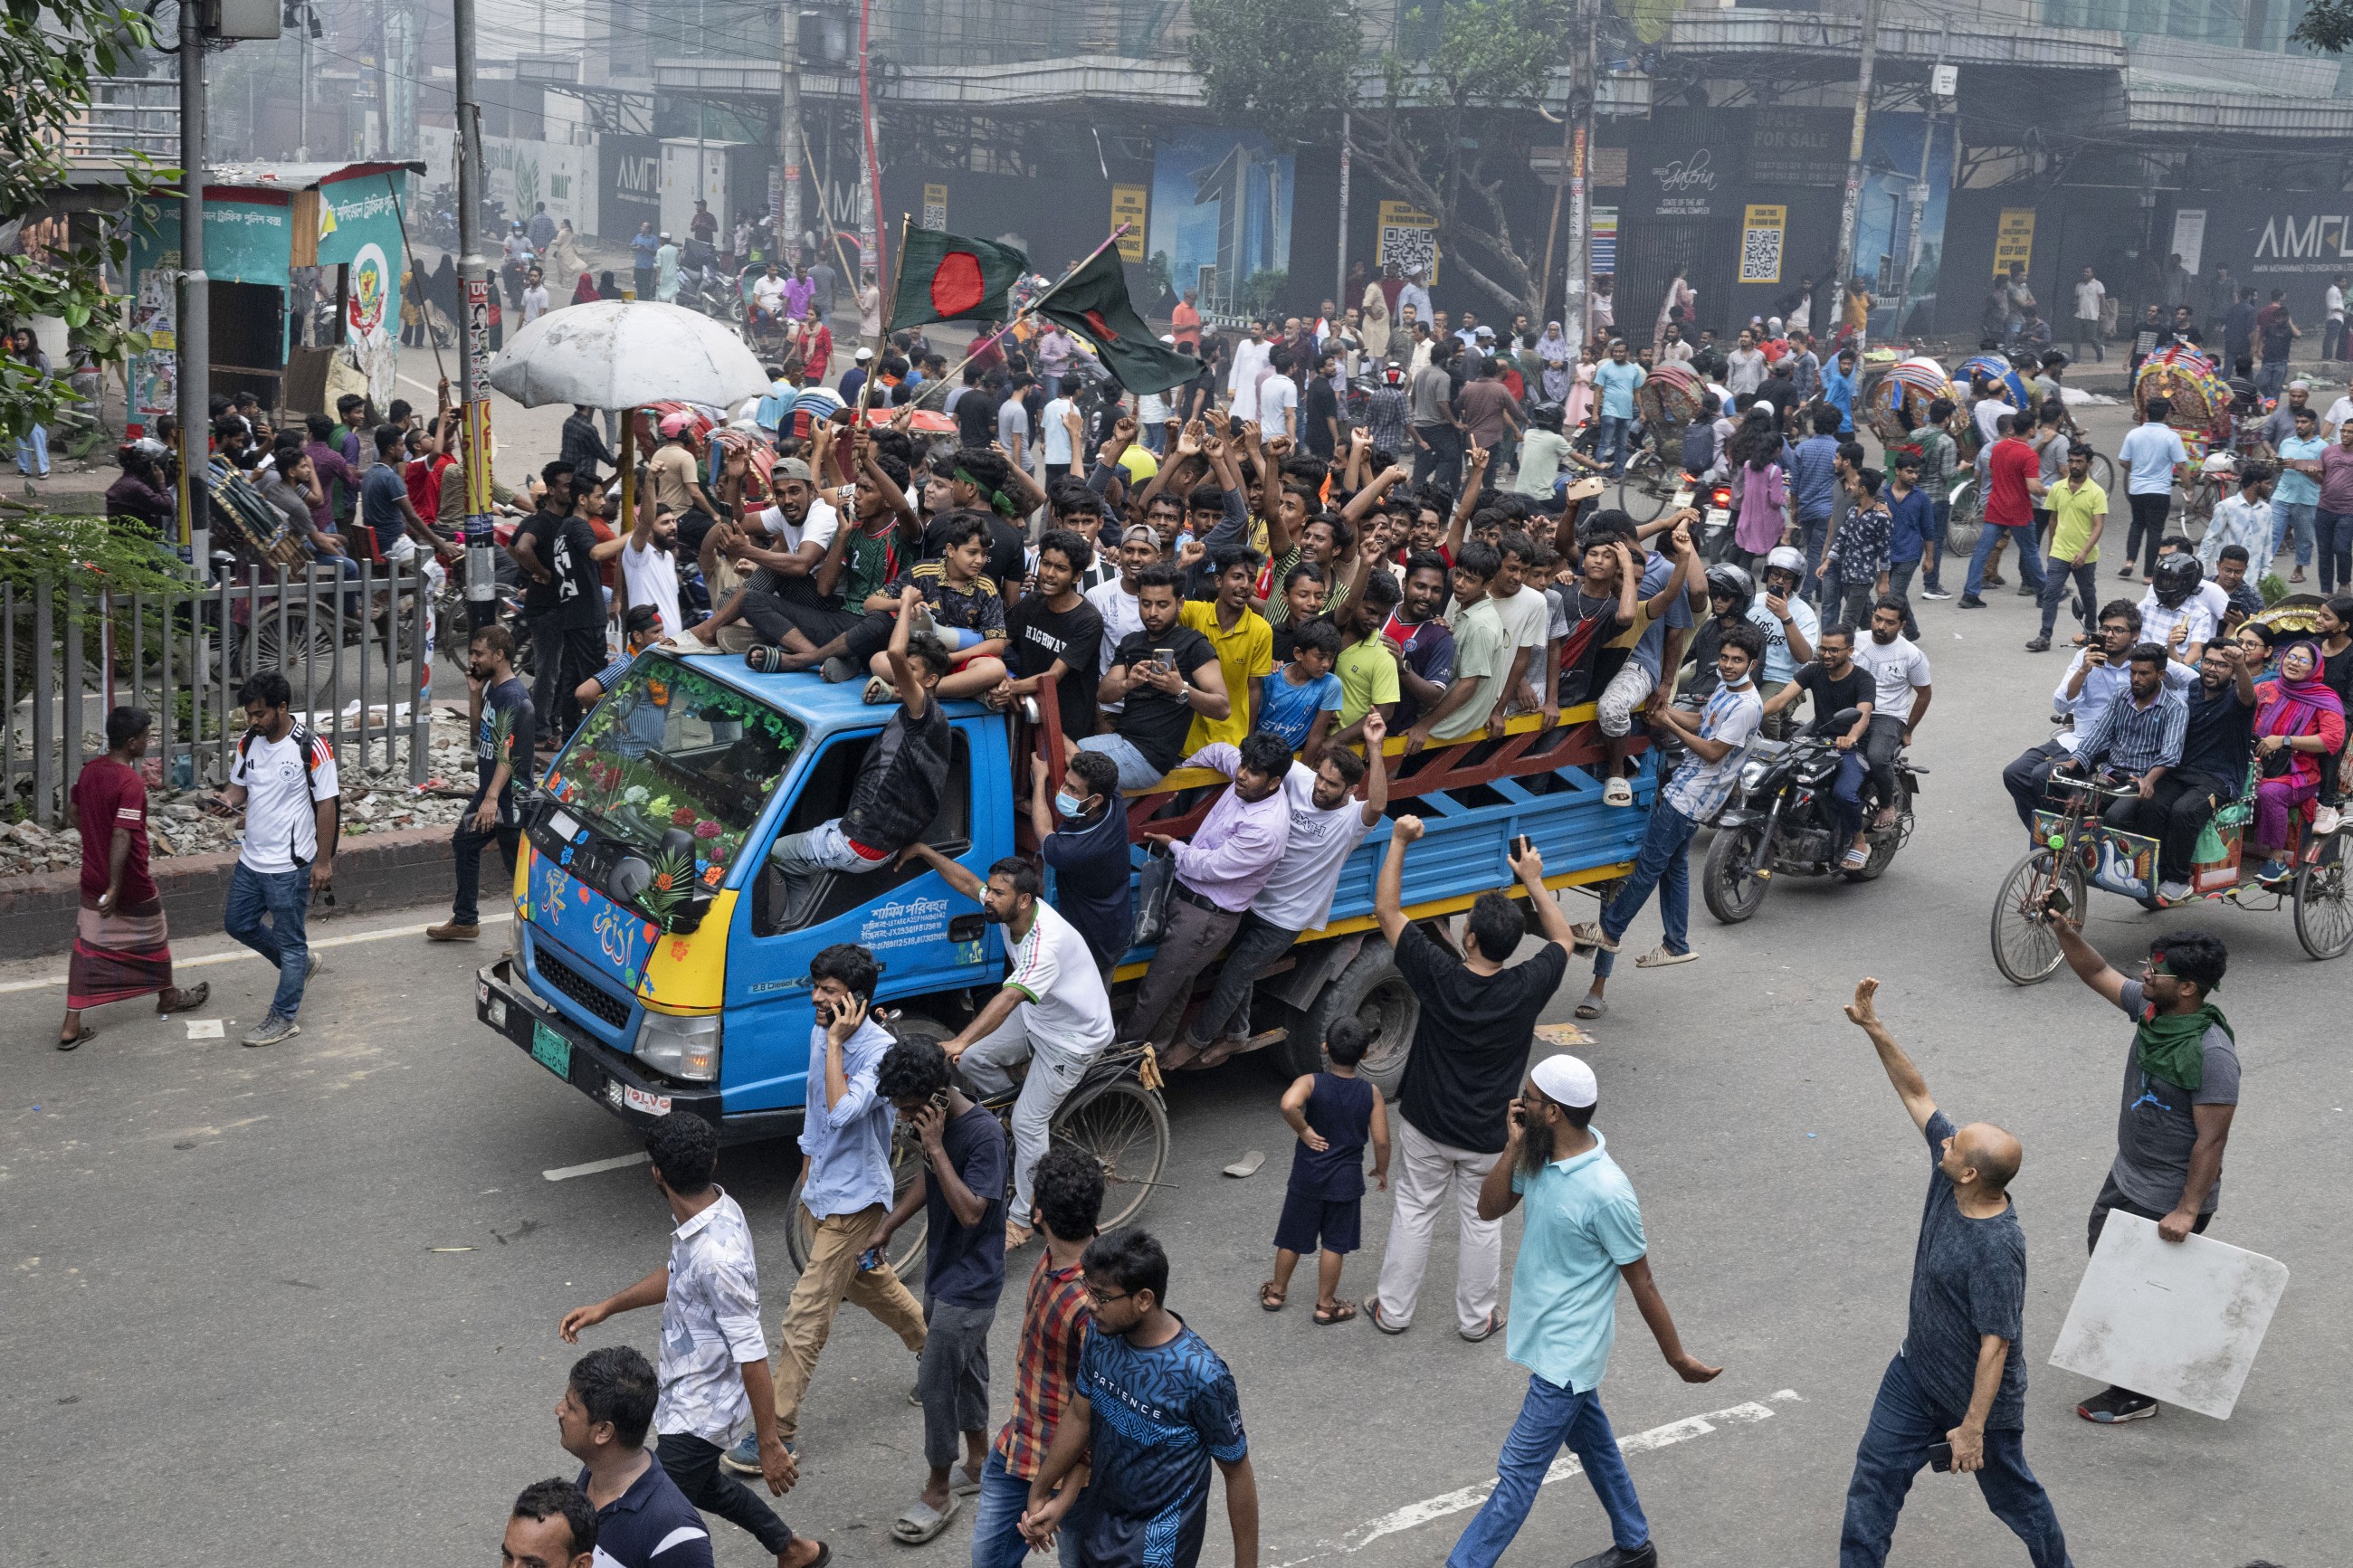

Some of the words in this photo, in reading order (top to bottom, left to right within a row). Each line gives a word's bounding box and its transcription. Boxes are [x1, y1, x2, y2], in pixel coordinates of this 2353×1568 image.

[1754, 131, 1785, 147] FOR
[1790, 133, 1828, 147] SALE
[244, 212, 265, 225] পুলিশ
[2253, 264, 2268, 272] AMIN
[2269, 264, 2304, 272] MOHAMMAD
[2306, 264, 2342, 272] FOUNDATION
[1024, 624, 1067, 653] HIGHWAY
[1291, 809, 1327, 839] PATH
[906, 898, 949, 916] পরিবহন
[752, 982, 766, 993] 2.8
[767, 979, 793, 990] Diesel
[625, 1086, 672, 1110] VOLVO
[1092, 1370, 1162, 1421] PATIENCE
